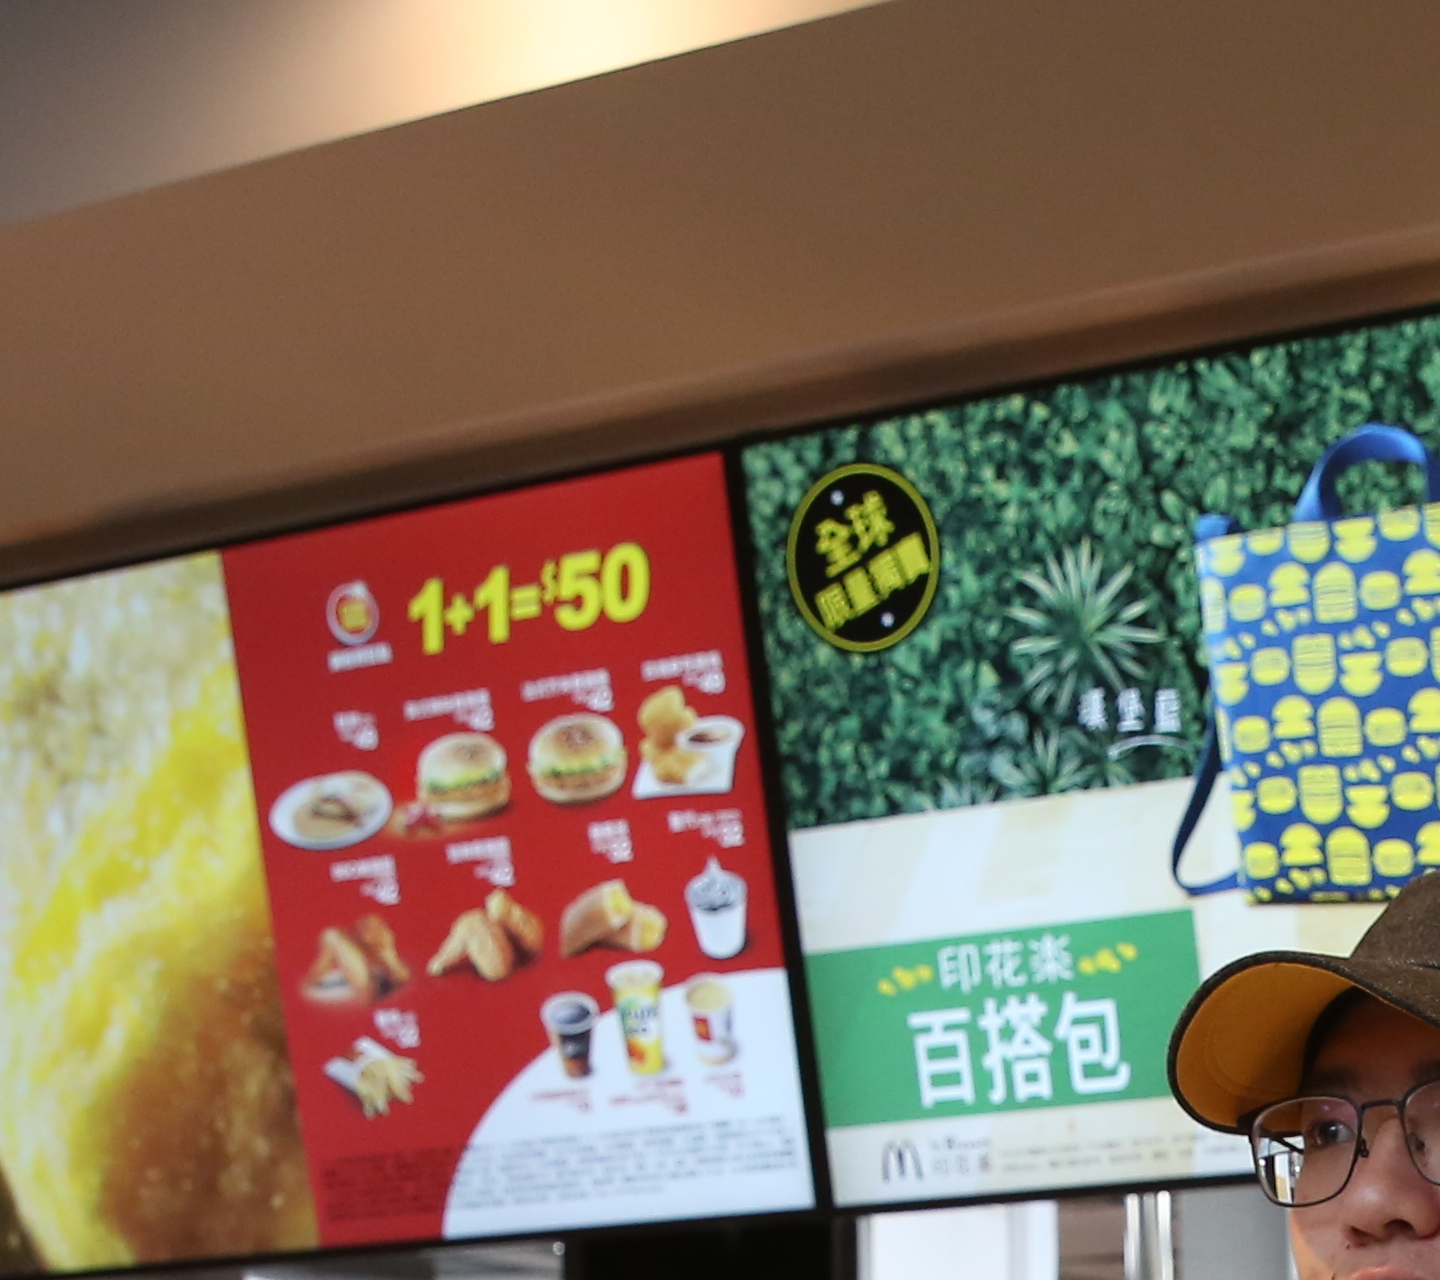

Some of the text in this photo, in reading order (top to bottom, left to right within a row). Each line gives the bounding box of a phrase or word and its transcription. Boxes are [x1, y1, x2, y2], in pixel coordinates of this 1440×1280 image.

[407, 542, 650, 655] 1+1=$50
[907, 991, 1131, 1109] 百搭包
